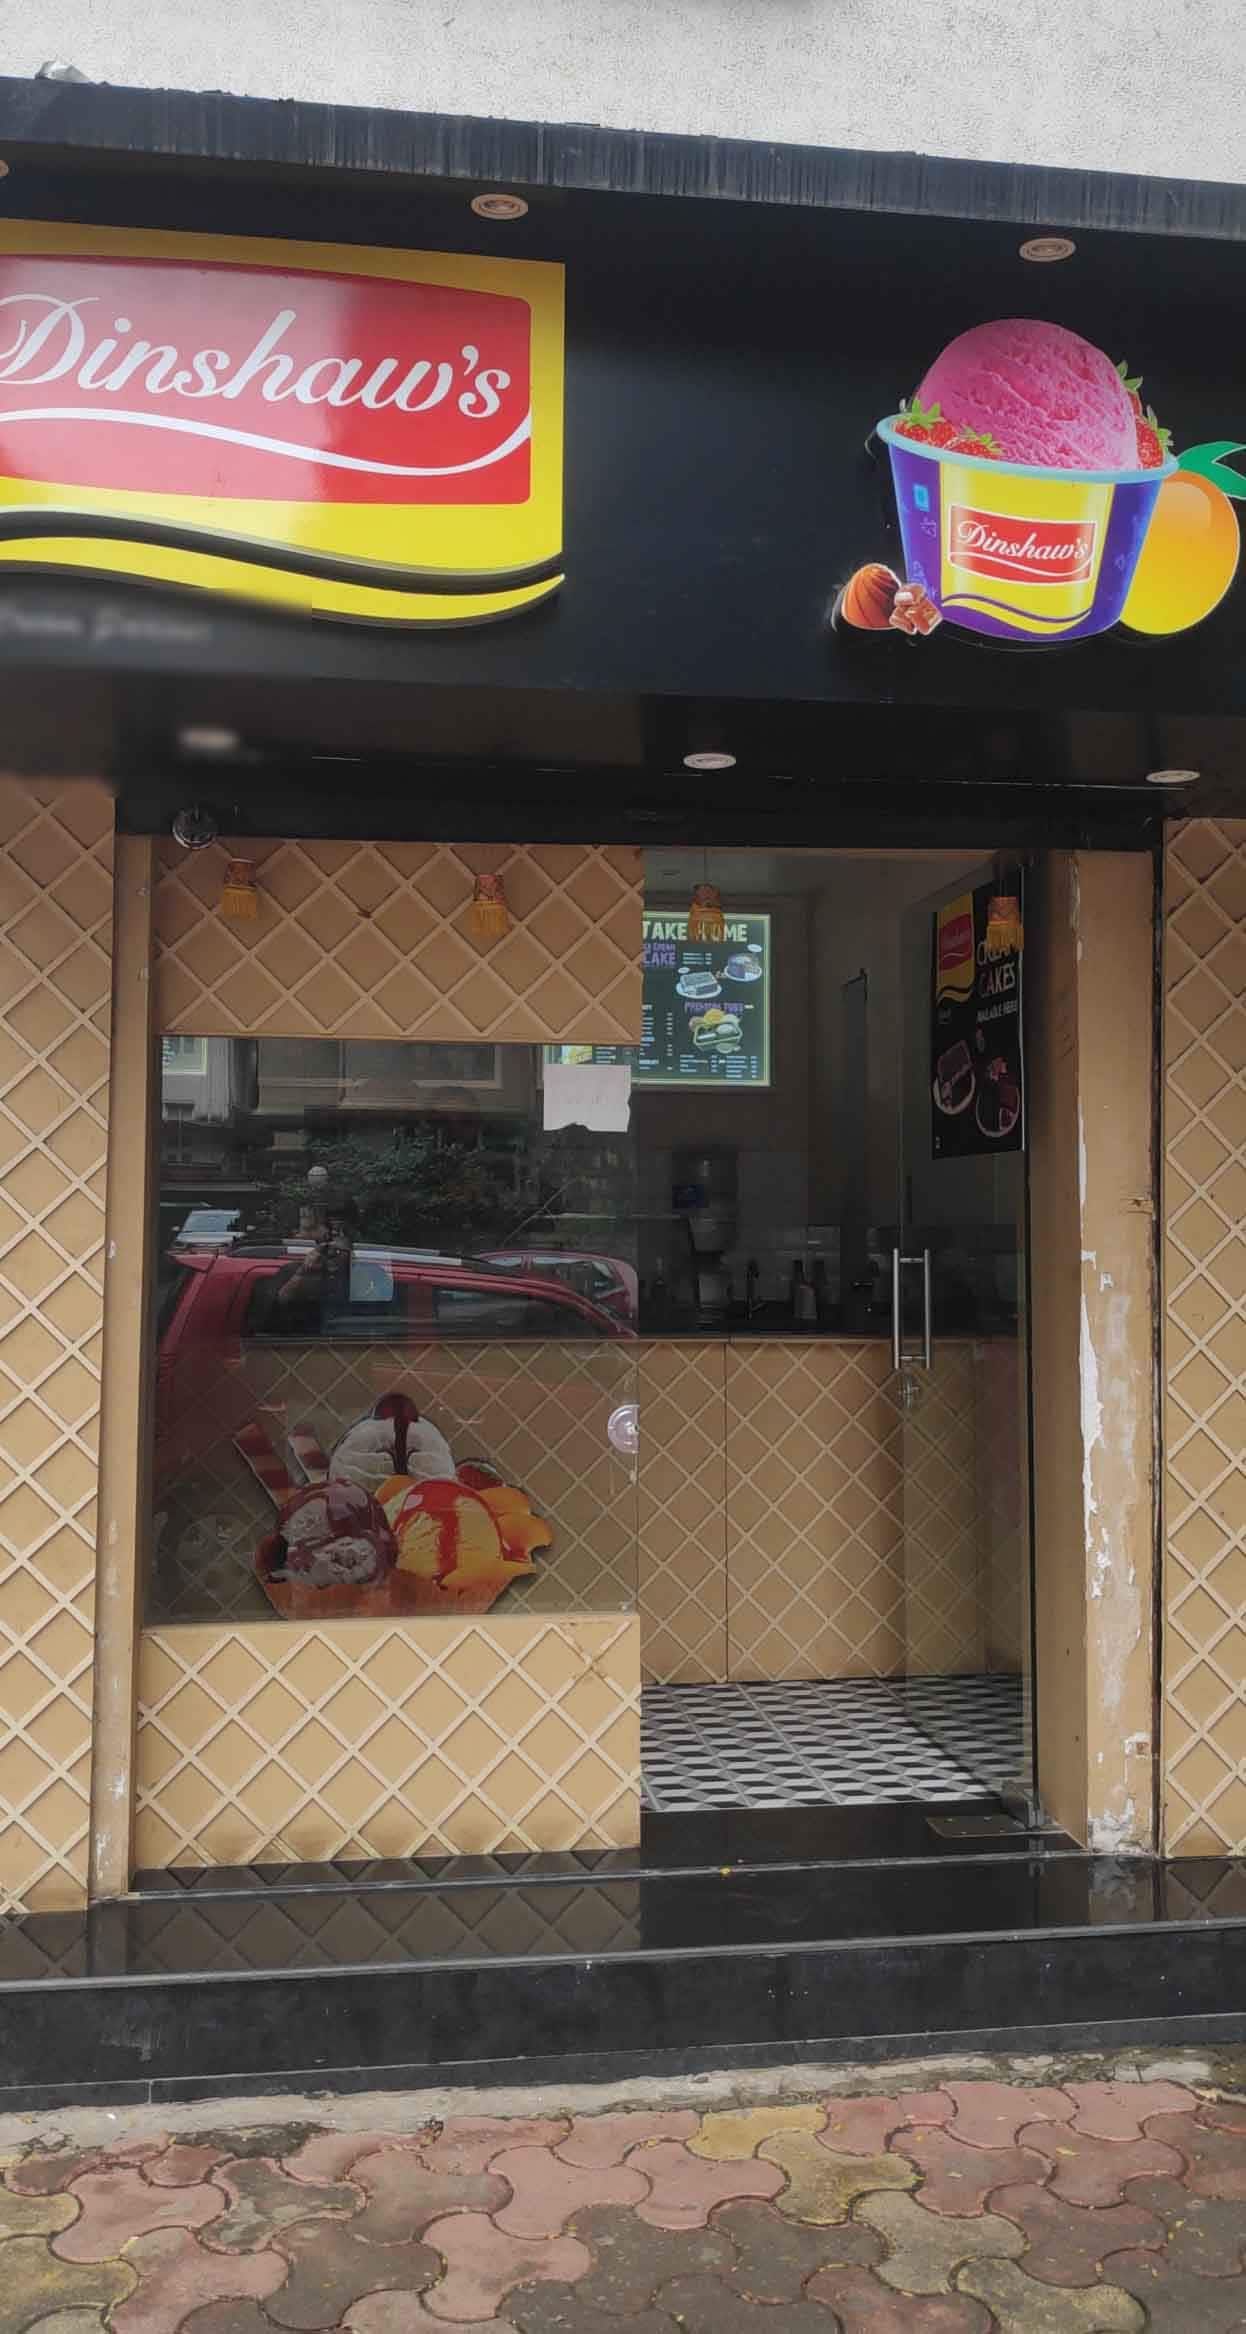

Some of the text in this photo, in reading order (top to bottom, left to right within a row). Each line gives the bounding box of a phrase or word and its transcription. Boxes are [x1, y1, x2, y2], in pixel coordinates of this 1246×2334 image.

[0, 293, 511, 418] Dinshaw's
[957, 520, 1089, 561] Dinshaw's
[642, 921, 688, 941] TAKE
